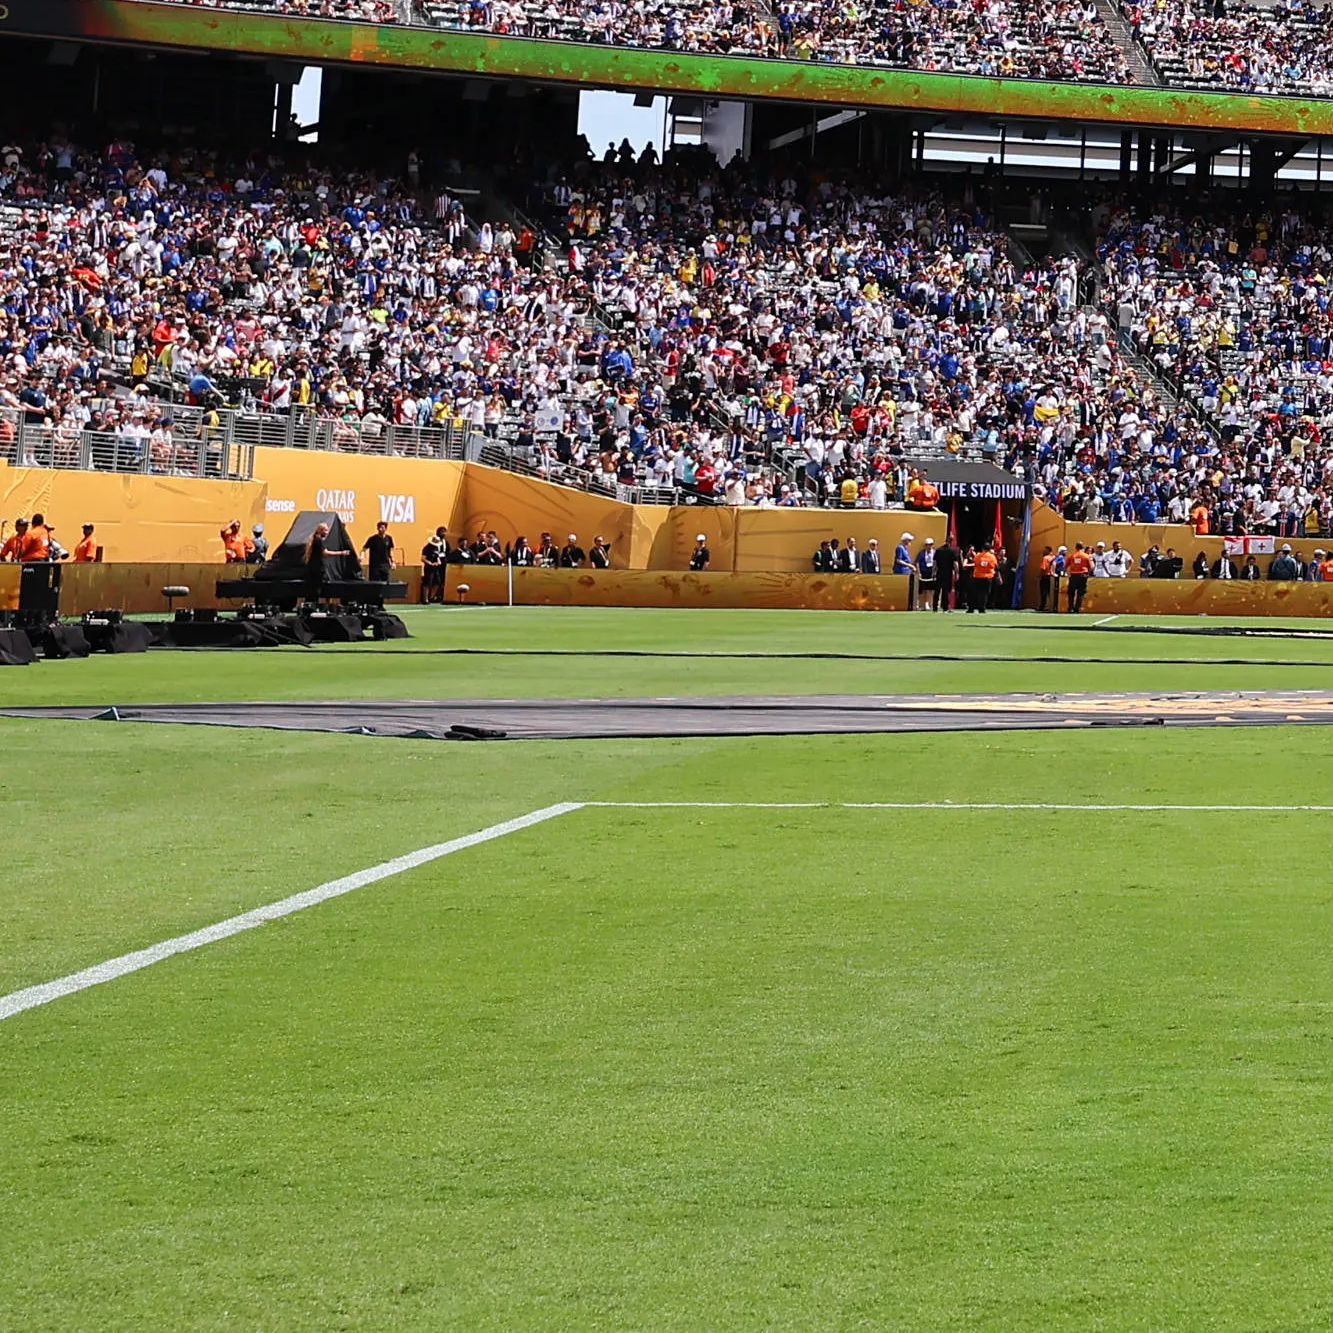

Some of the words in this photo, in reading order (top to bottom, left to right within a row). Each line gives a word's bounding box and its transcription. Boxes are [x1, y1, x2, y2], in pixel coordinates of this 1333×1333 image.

[316, 488, 356, 512] QATAR
[970, 483, 1026, 500] STADIUM
[377, 494, 415, 523] VISA
